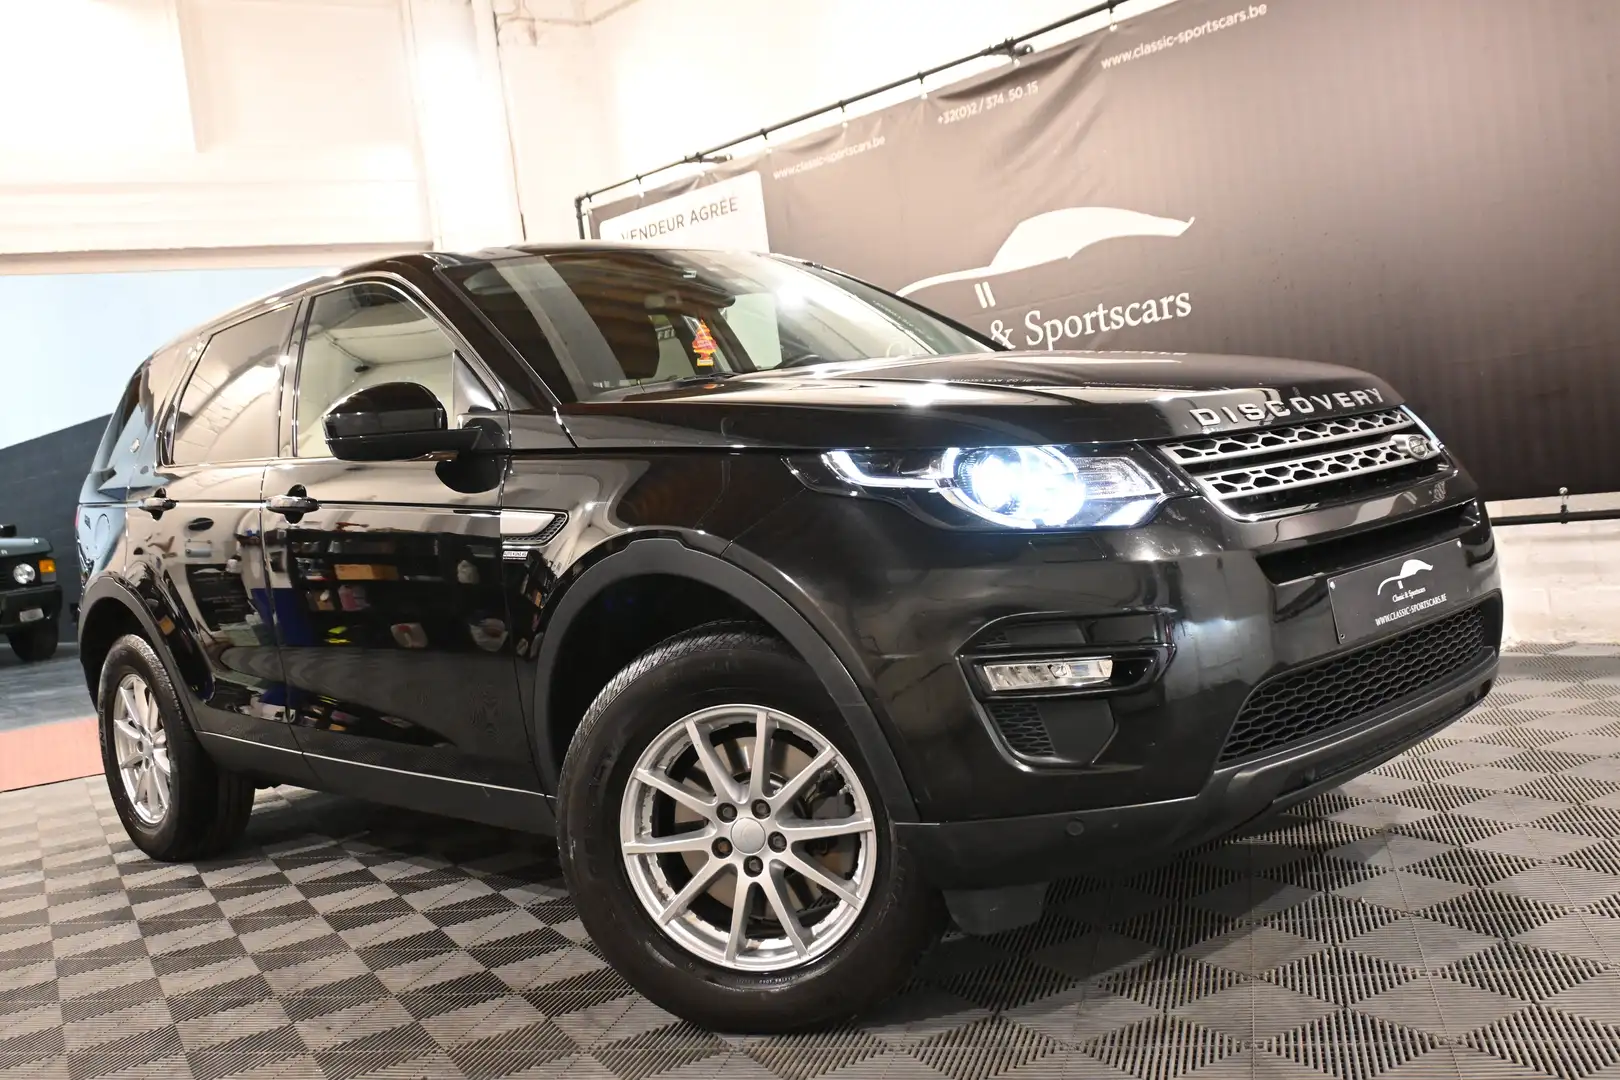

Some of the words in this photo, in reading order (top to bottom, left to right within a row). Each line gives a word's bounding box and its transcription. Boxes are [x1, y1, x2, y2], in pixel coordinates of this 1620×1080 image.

[1100, 3, 1268, 70] www.classic-sportscars.be
[985, 80, 1039, 110] 374.50.15
[773, 136, 886, 180] www.classic-sportscars.be
[989, 319, 1016, 350] &
[1024, 291, 1193, 351] Sportscars
[1189, 388, 1384, 427] DISCOVERY
[1374, 593, 1447, 626] WWW.CLASSIC-SPORTSCARS.BE
